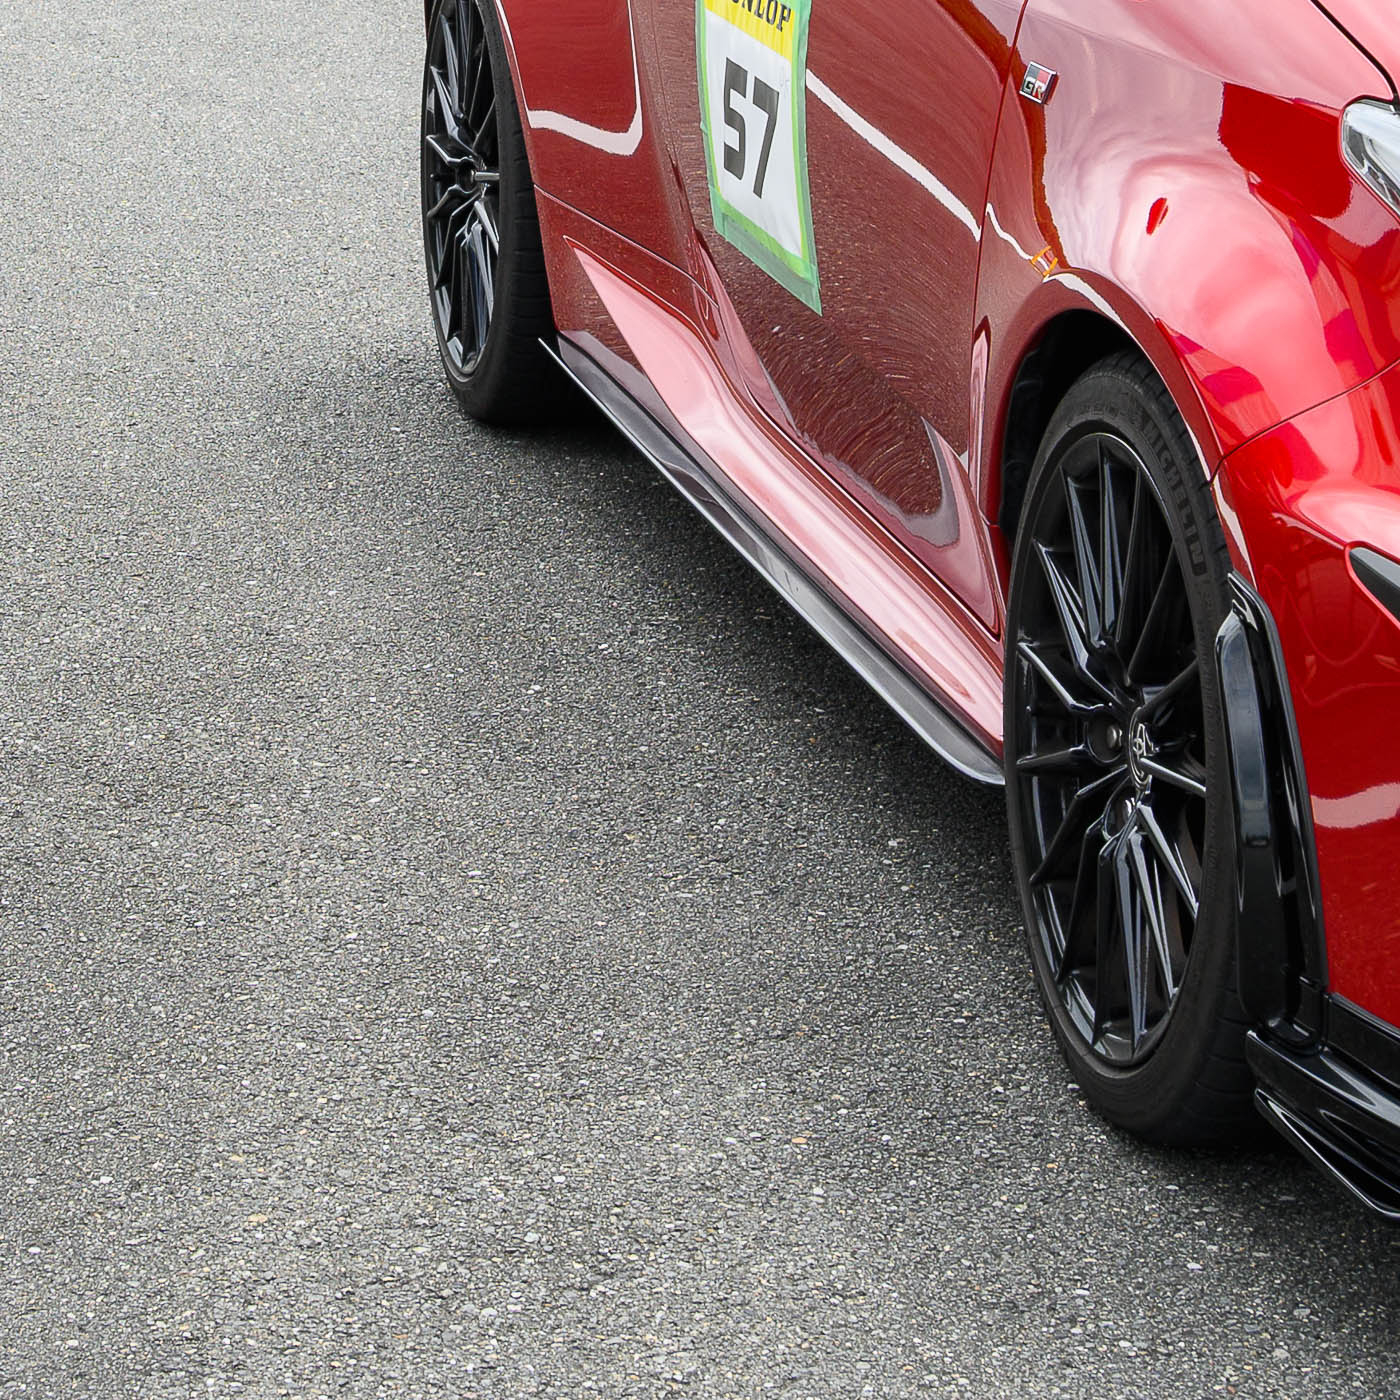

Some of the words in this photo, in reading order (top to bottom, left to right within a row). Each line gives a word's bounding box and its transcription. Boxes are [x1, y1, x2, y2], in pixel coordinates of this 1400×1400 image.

[723, 56, 780, 200] 57
[1023, 77, 1047, 99] GR
[1142, 418, 1207, 567] MICHELIN
